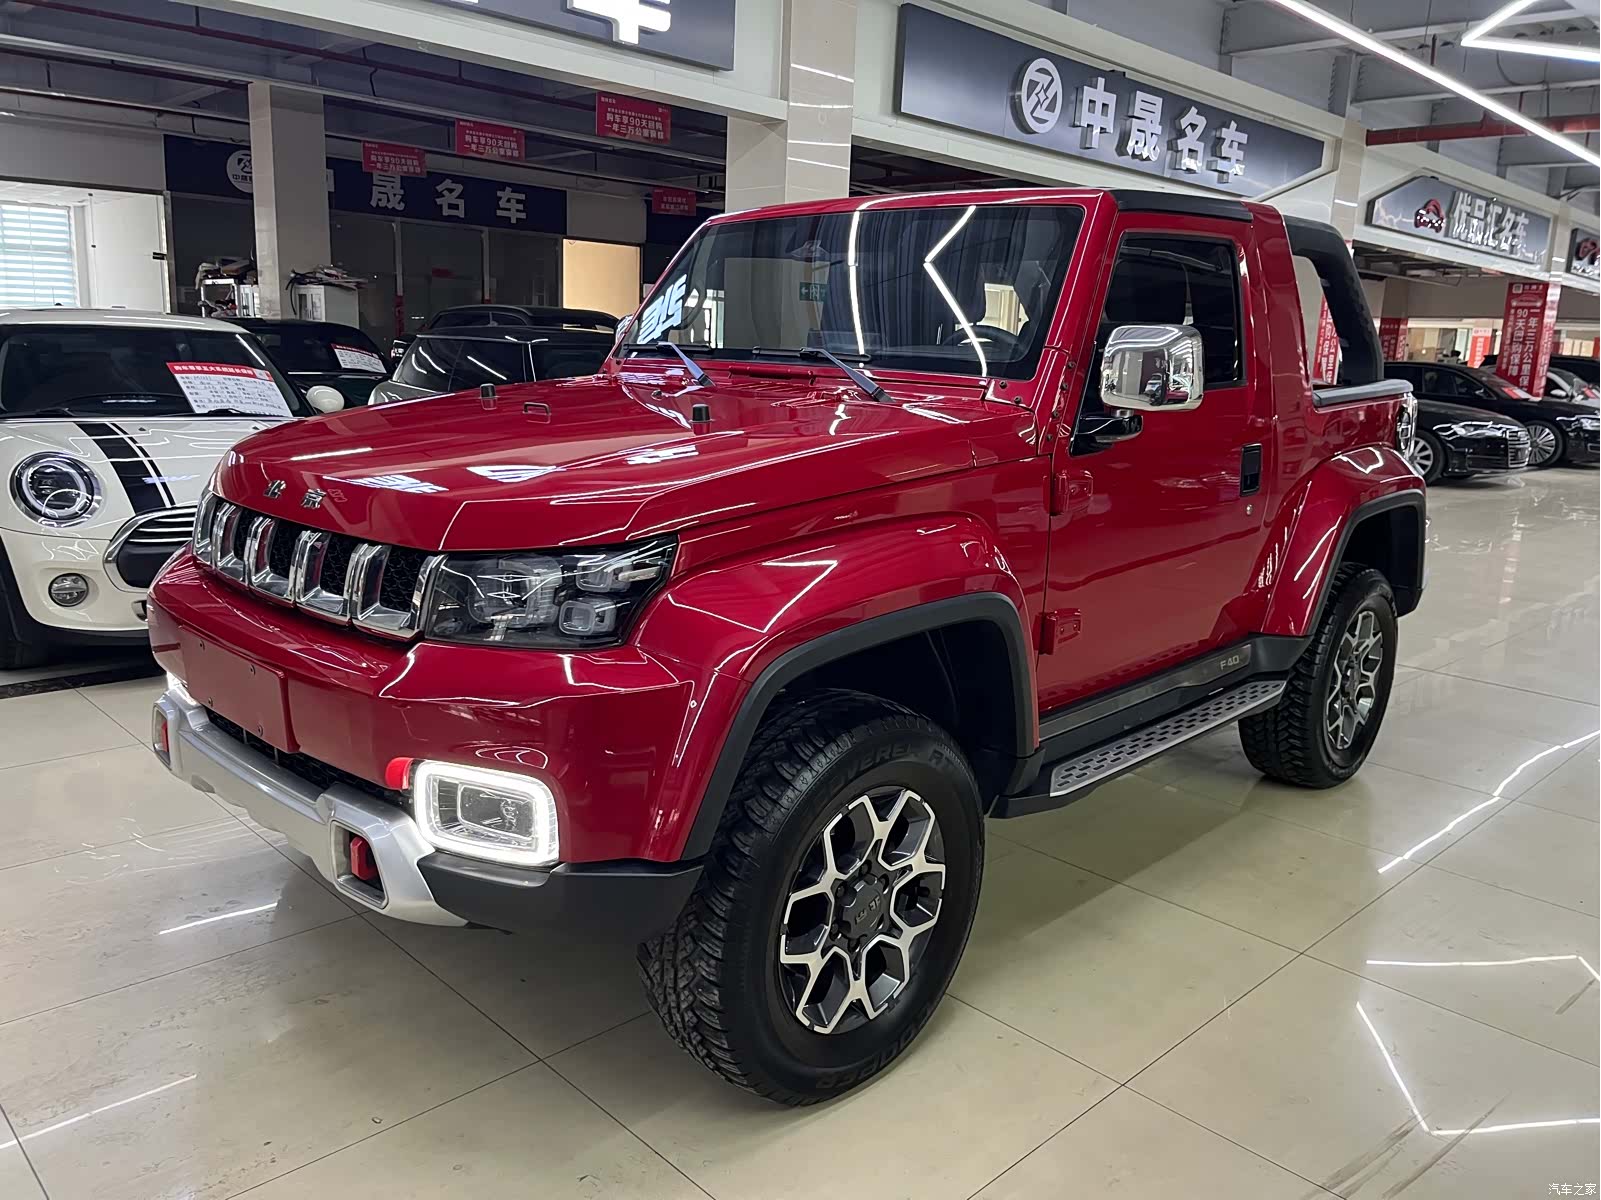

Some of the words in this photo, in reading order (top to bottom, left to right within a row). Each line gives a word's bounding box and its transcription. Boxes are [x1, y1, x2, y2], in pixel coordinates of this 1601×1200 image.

[1077, 77, 1248, 184] 中晟名车
[1520, 309, 1541, 391] 一年三万公里保
